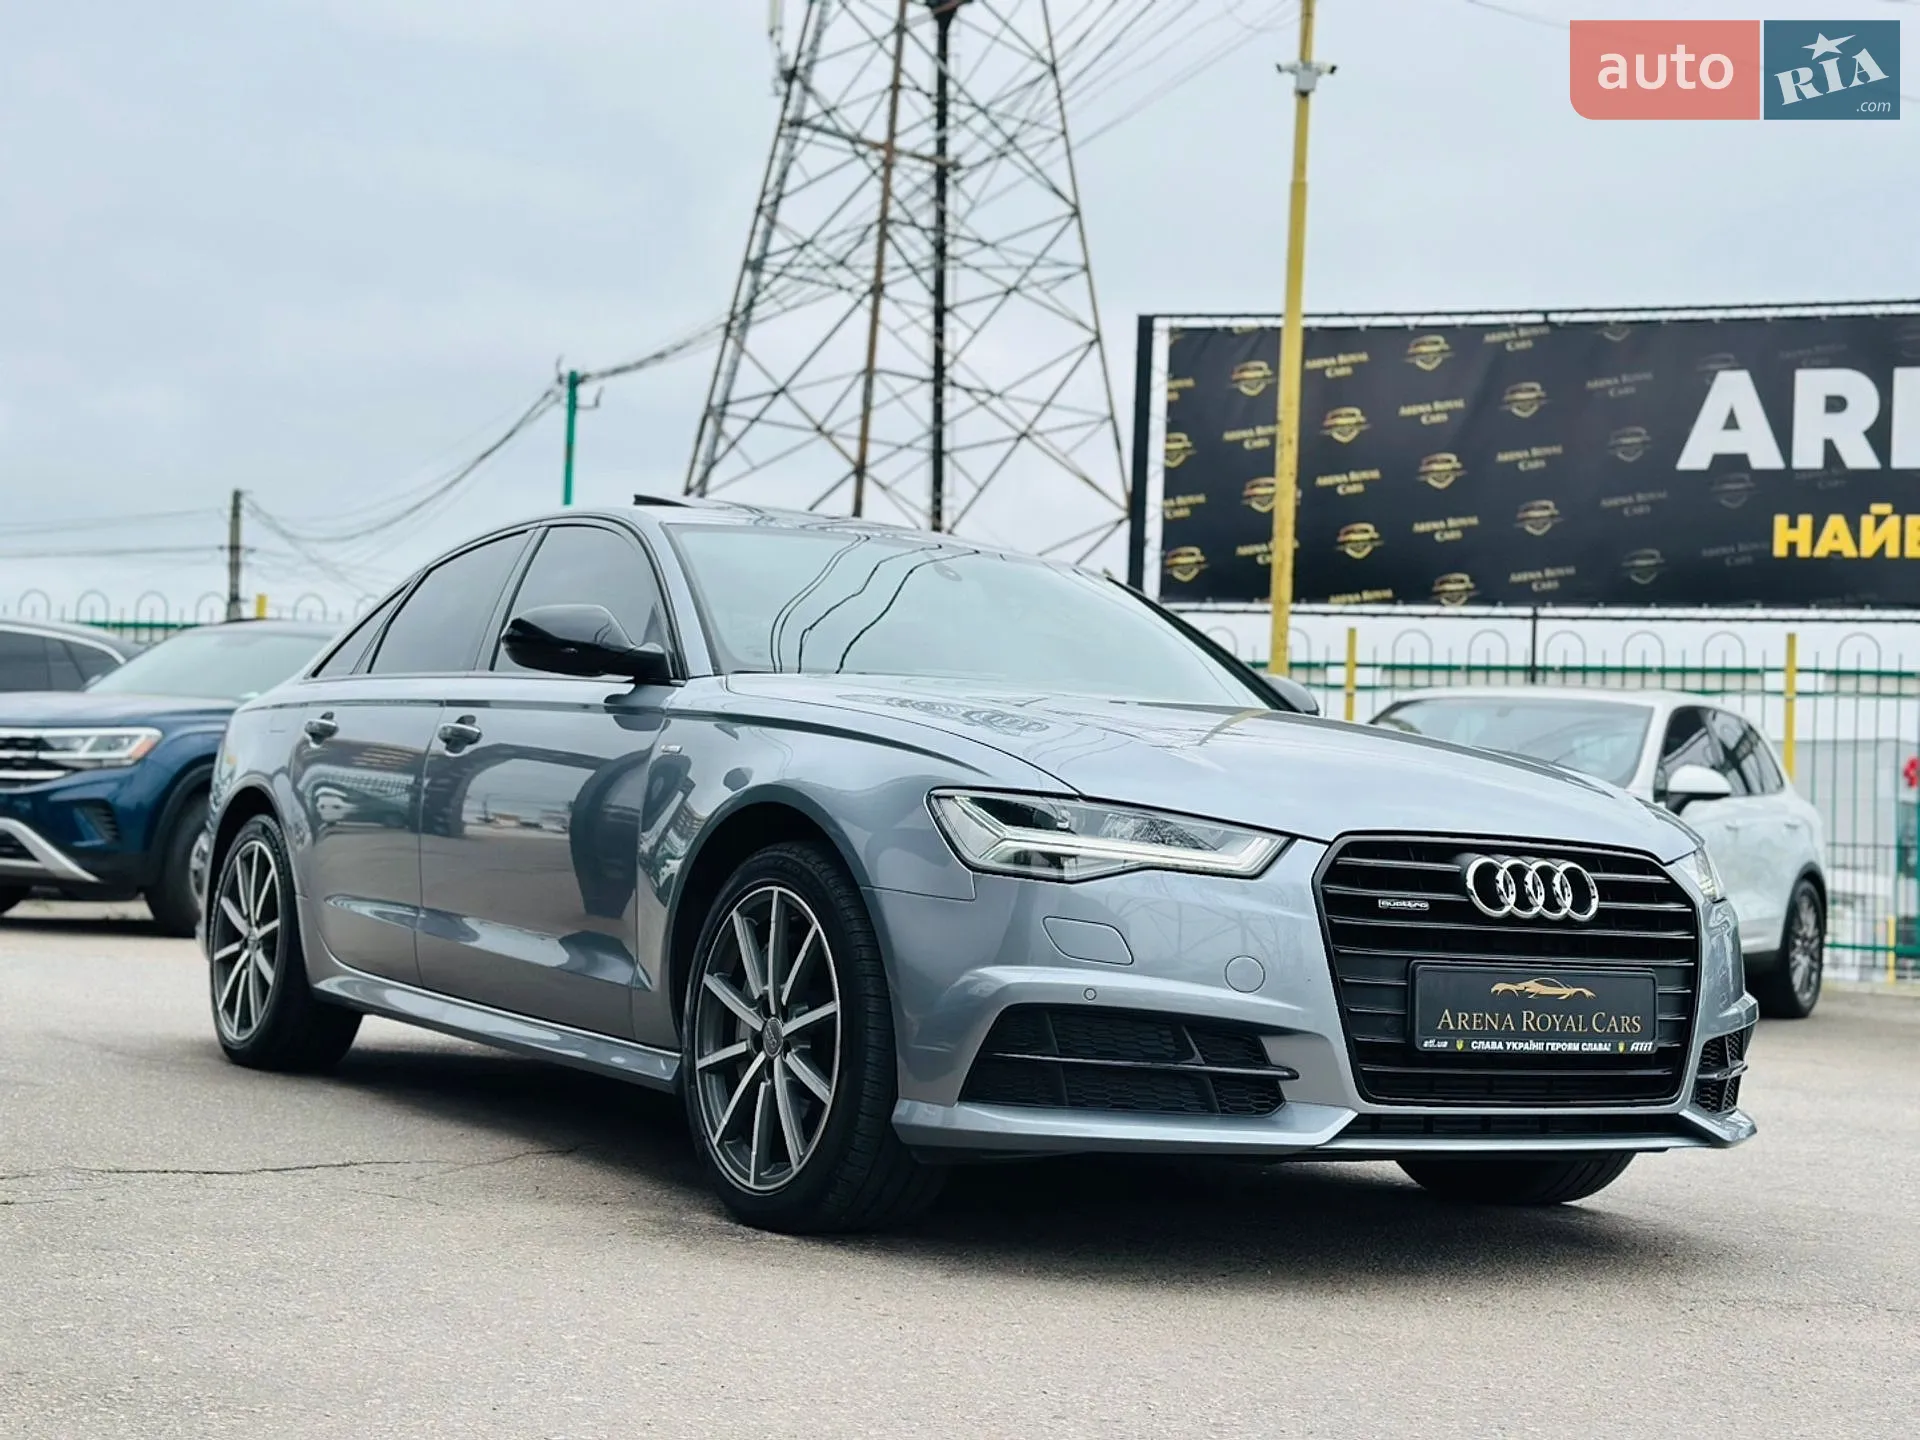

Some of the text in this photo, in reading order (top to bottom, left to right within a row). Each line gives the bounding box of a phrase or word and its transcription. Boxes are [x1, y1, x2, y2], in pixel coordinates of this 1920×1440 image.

[1436, 1008, 1642, 1034] ARENA ROYAL CARS
